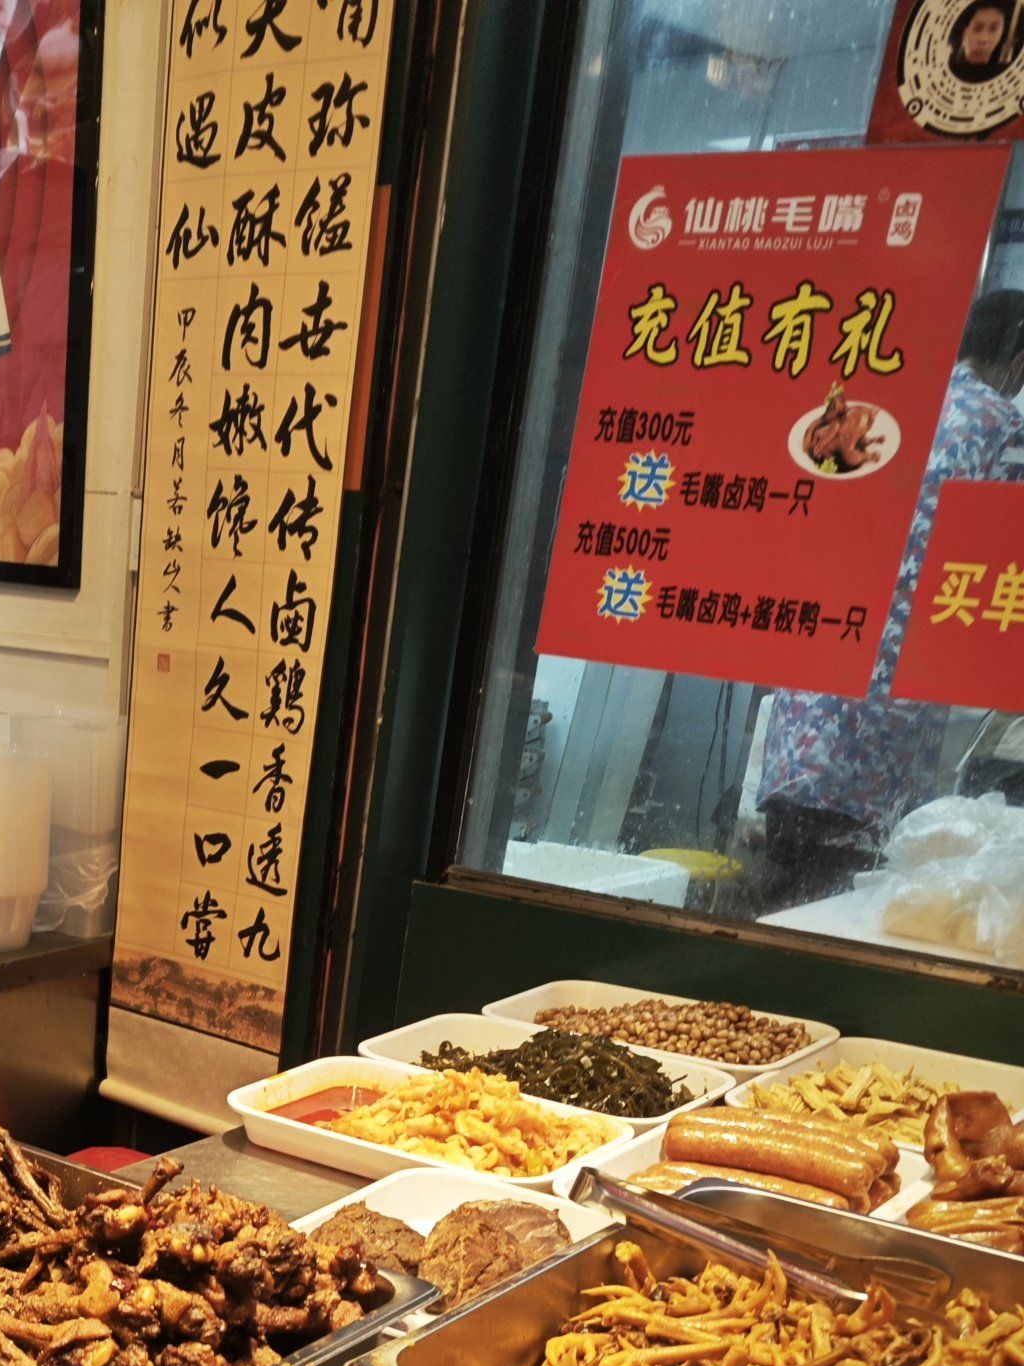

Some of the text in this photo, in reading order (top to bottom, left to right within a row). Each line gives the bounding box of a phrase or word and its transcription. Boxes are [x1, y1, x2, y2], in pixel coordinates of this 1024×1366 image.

[683, 194, 868, 234] 仙桃毛嘴
[890, 199, 917, 241] 卤鸡
[697, 237, 834, 250] XIANTAO MAOZUI LUJI
[624, 279, 904, 378] 充值有礼
[594, 406, 694, 446] 充值300元
[621, 452, 814, 516] 送 毛嘴卤鸡一只
[574, 519, 671, 561] 充值500元
[596, 567, 867, 641] 送 毛嘴卤鸡+酱板鸭一只
[930, 562, 1024, 633] 买单
